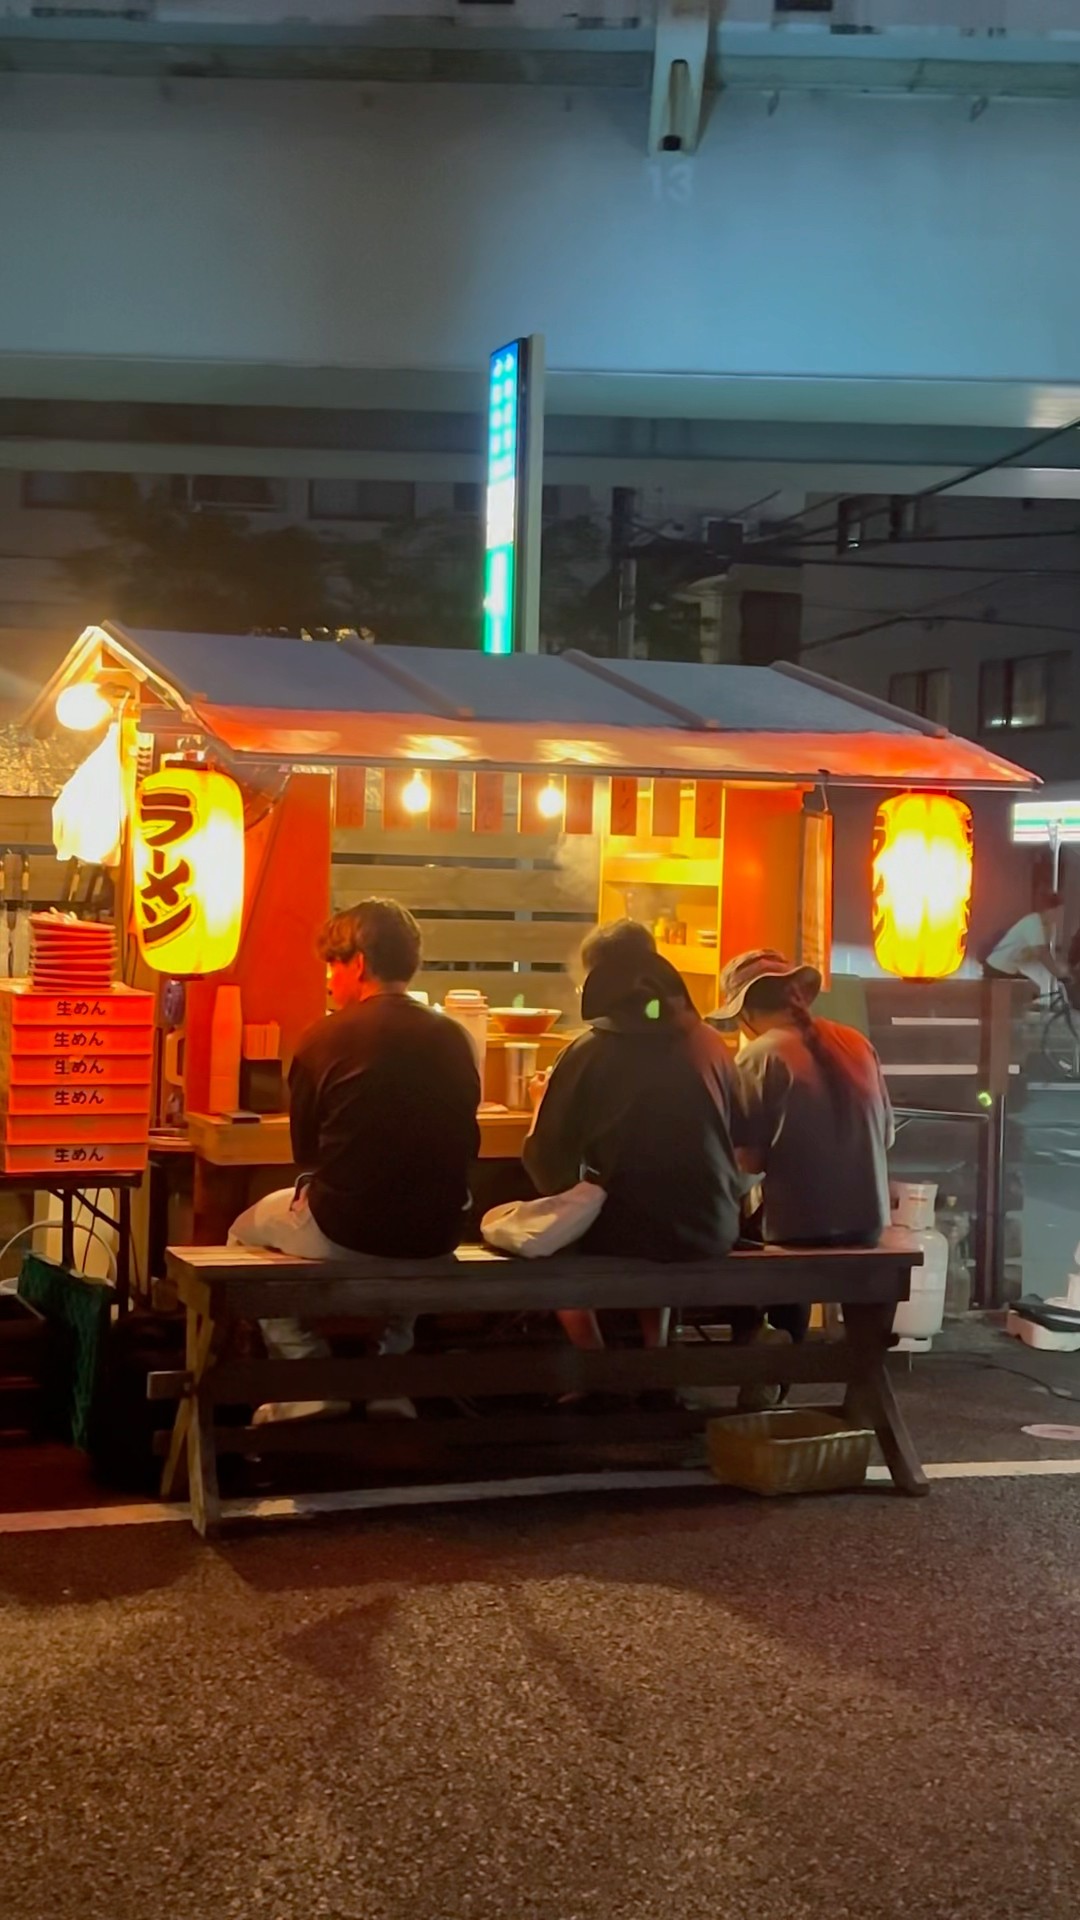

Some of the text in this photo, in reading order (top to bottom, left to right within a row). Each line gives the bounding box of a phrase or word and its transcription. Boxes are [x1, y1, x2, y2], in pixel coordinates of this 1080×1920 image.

[139, 791, 195, 945] ラーメン
[56, 1001, 106, 1016] 生めん
[54, 1032, 104, 1047] 生めん
[54, 1091, 104, 1106] 生めん
[54, 1147, 104, 1163] 生めん
